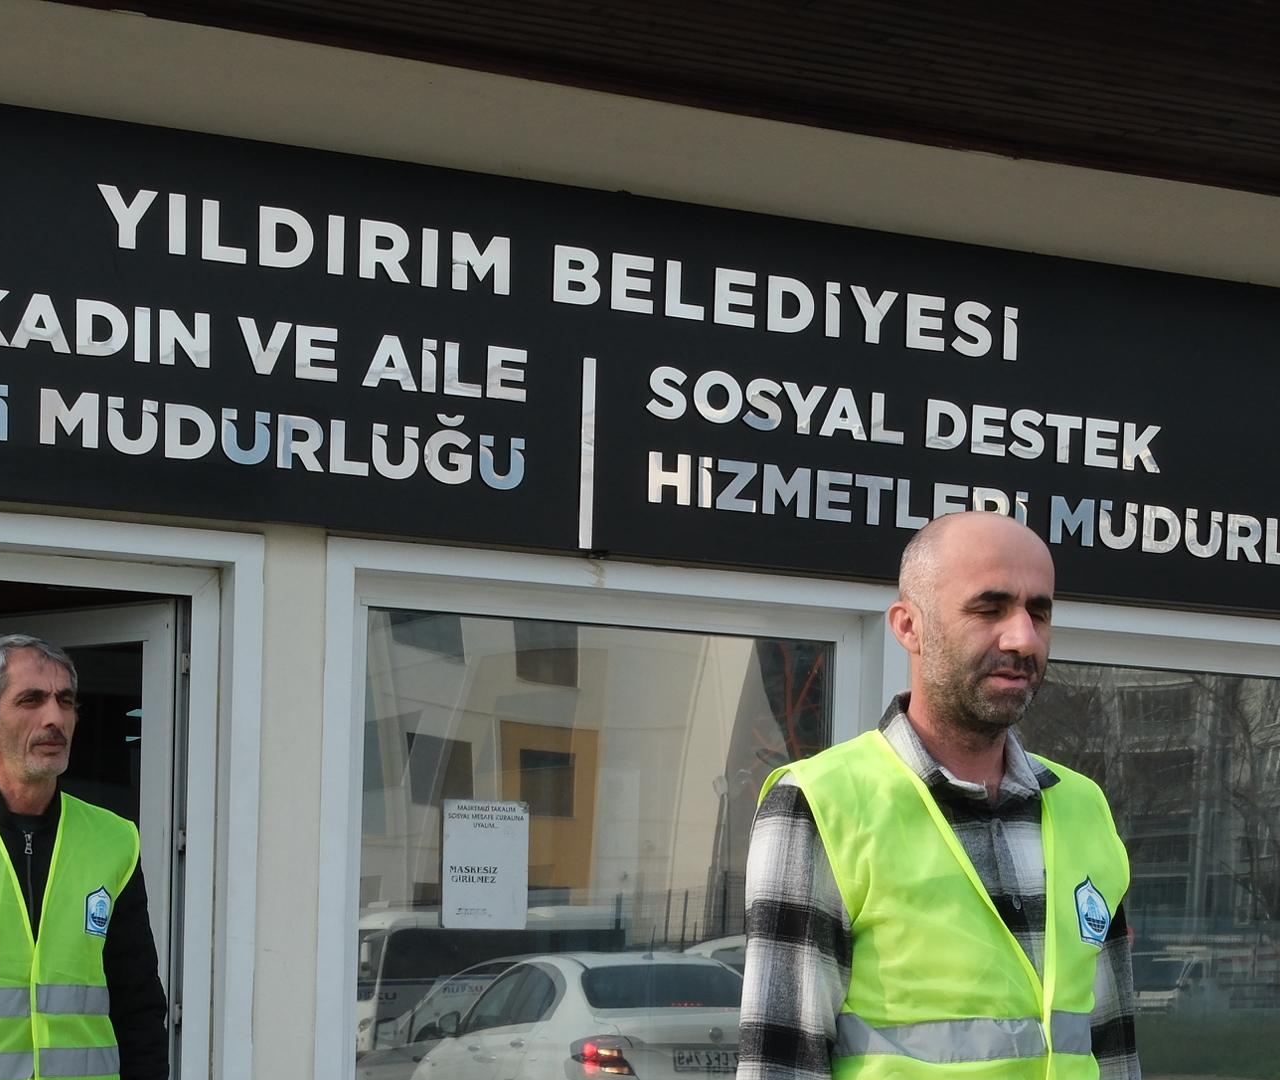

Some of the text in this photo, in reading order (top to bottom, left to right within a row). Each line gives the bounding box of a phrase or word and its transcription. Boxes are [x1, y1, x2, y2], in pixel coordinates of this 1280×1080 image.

[96, 183, 1019, 361] YILDIRIM BELEDİYESİ
[237, 316, 339, 383] VE
[361, 334, 528, 403] AİLE
[39, 387, 526, 491] MÜDÜRLÜĞÜ
[645, 365, 1162, 474] SOSYAL DESTEK
[449, 865, 498, 875] MASKESİZ
[451, 874, 497, 884] GİRİLMEZ
